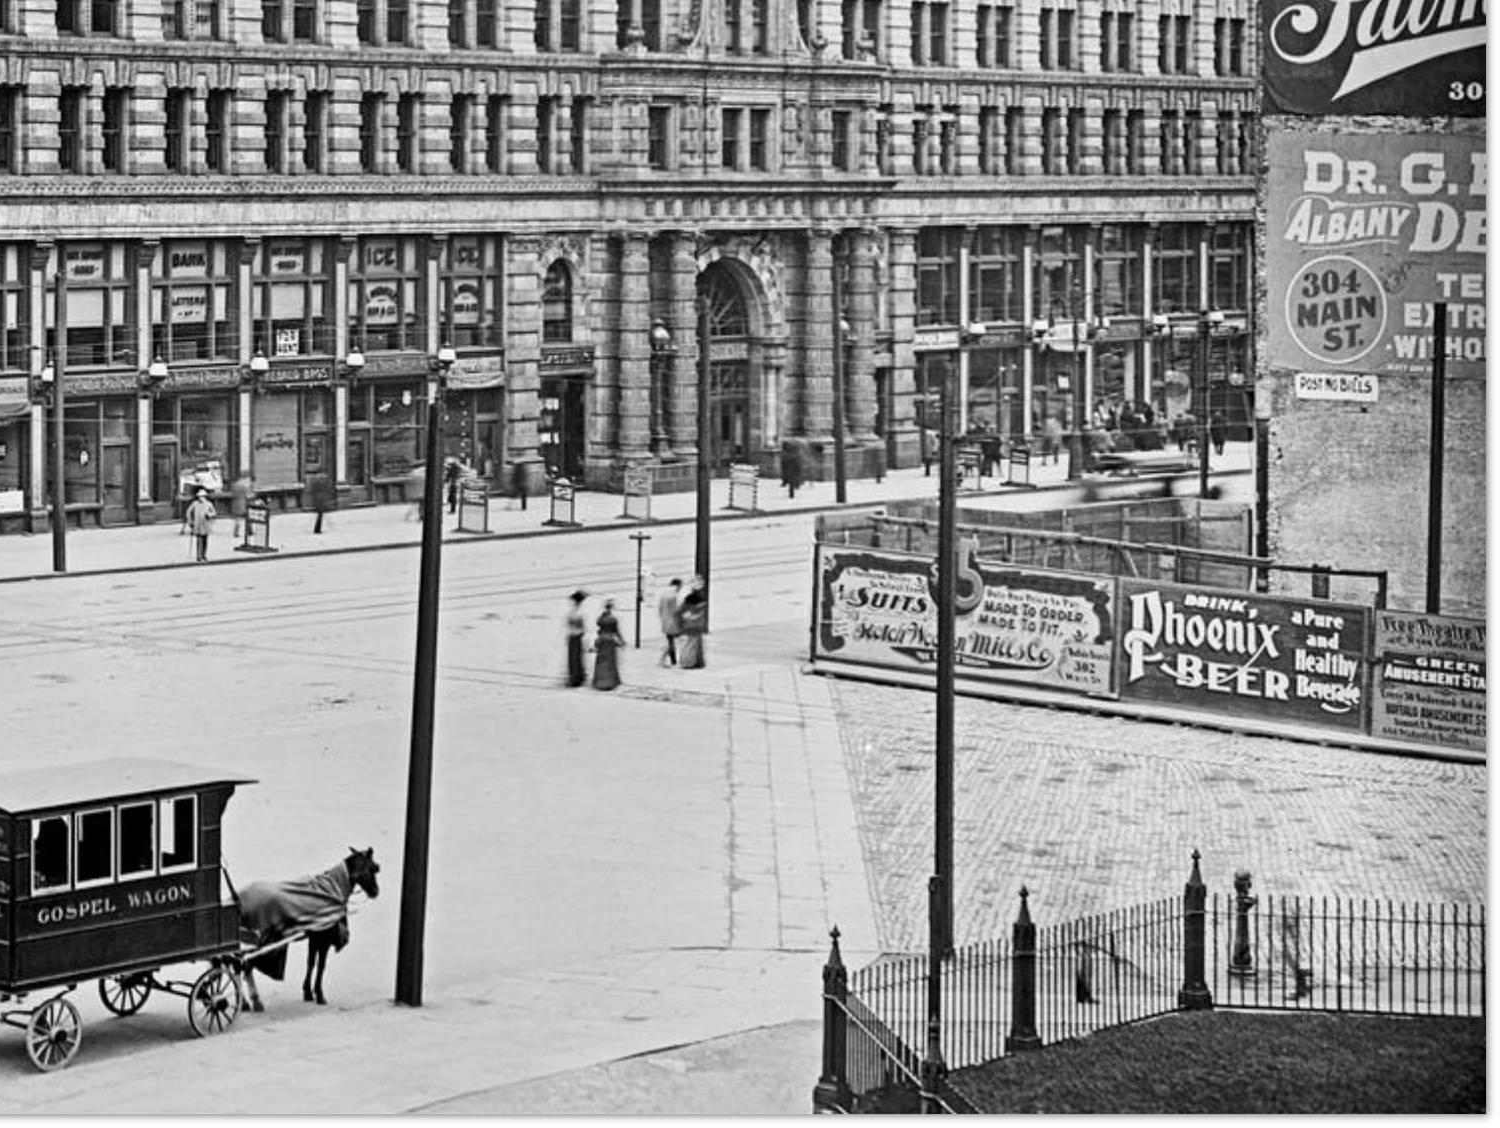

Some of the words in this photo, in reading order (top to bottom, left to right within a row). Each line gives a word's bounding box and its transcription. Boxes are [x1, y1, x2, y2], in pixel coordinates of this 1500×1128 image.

[1449, 80, 1486, 101] 30
[1304, 149, 1387, 194] DR.
[1401, 151, 1459, 195] G.
[1284, 199, 1411, 244] ALBANY
[172, 250, 206, 269] BANK
[367, 246, 397, 266] ICE
[1301, 269, 1361, 298] 304
[1436, 272, 1484, 299] TE
[1297, 295, 1377, 328] MAIN
[1322, 324, 1365, 352] ST.
[845, 587, 928, 613] SUITS
[984, 600, 1019, 616] MADE
[1021, 602, 1037, 618] TO
[978, 613, 1016, 630] MADE
[1021, 617, 1037, 632] TO
[1291, 610, 1302, 625] a
[1303, 608, 1345, 630] Pure
[1381, 616, 1416, 633] Free
[968, 630, 1025, 661] Mills
[1123, 591, 1281, 682] Phoenix
[1305, 632, 1340, 650] and
[1175, 653, 1290, 701] BEER
[1295, 648, 1359, 682] Healthy
[1415, 656, 1480, 673] GREEN
[1296, 674, 1361, 706] Beverage
[37, 897, 116, 924] GOSPEL
[127, 884, 193, 909] WAGON
